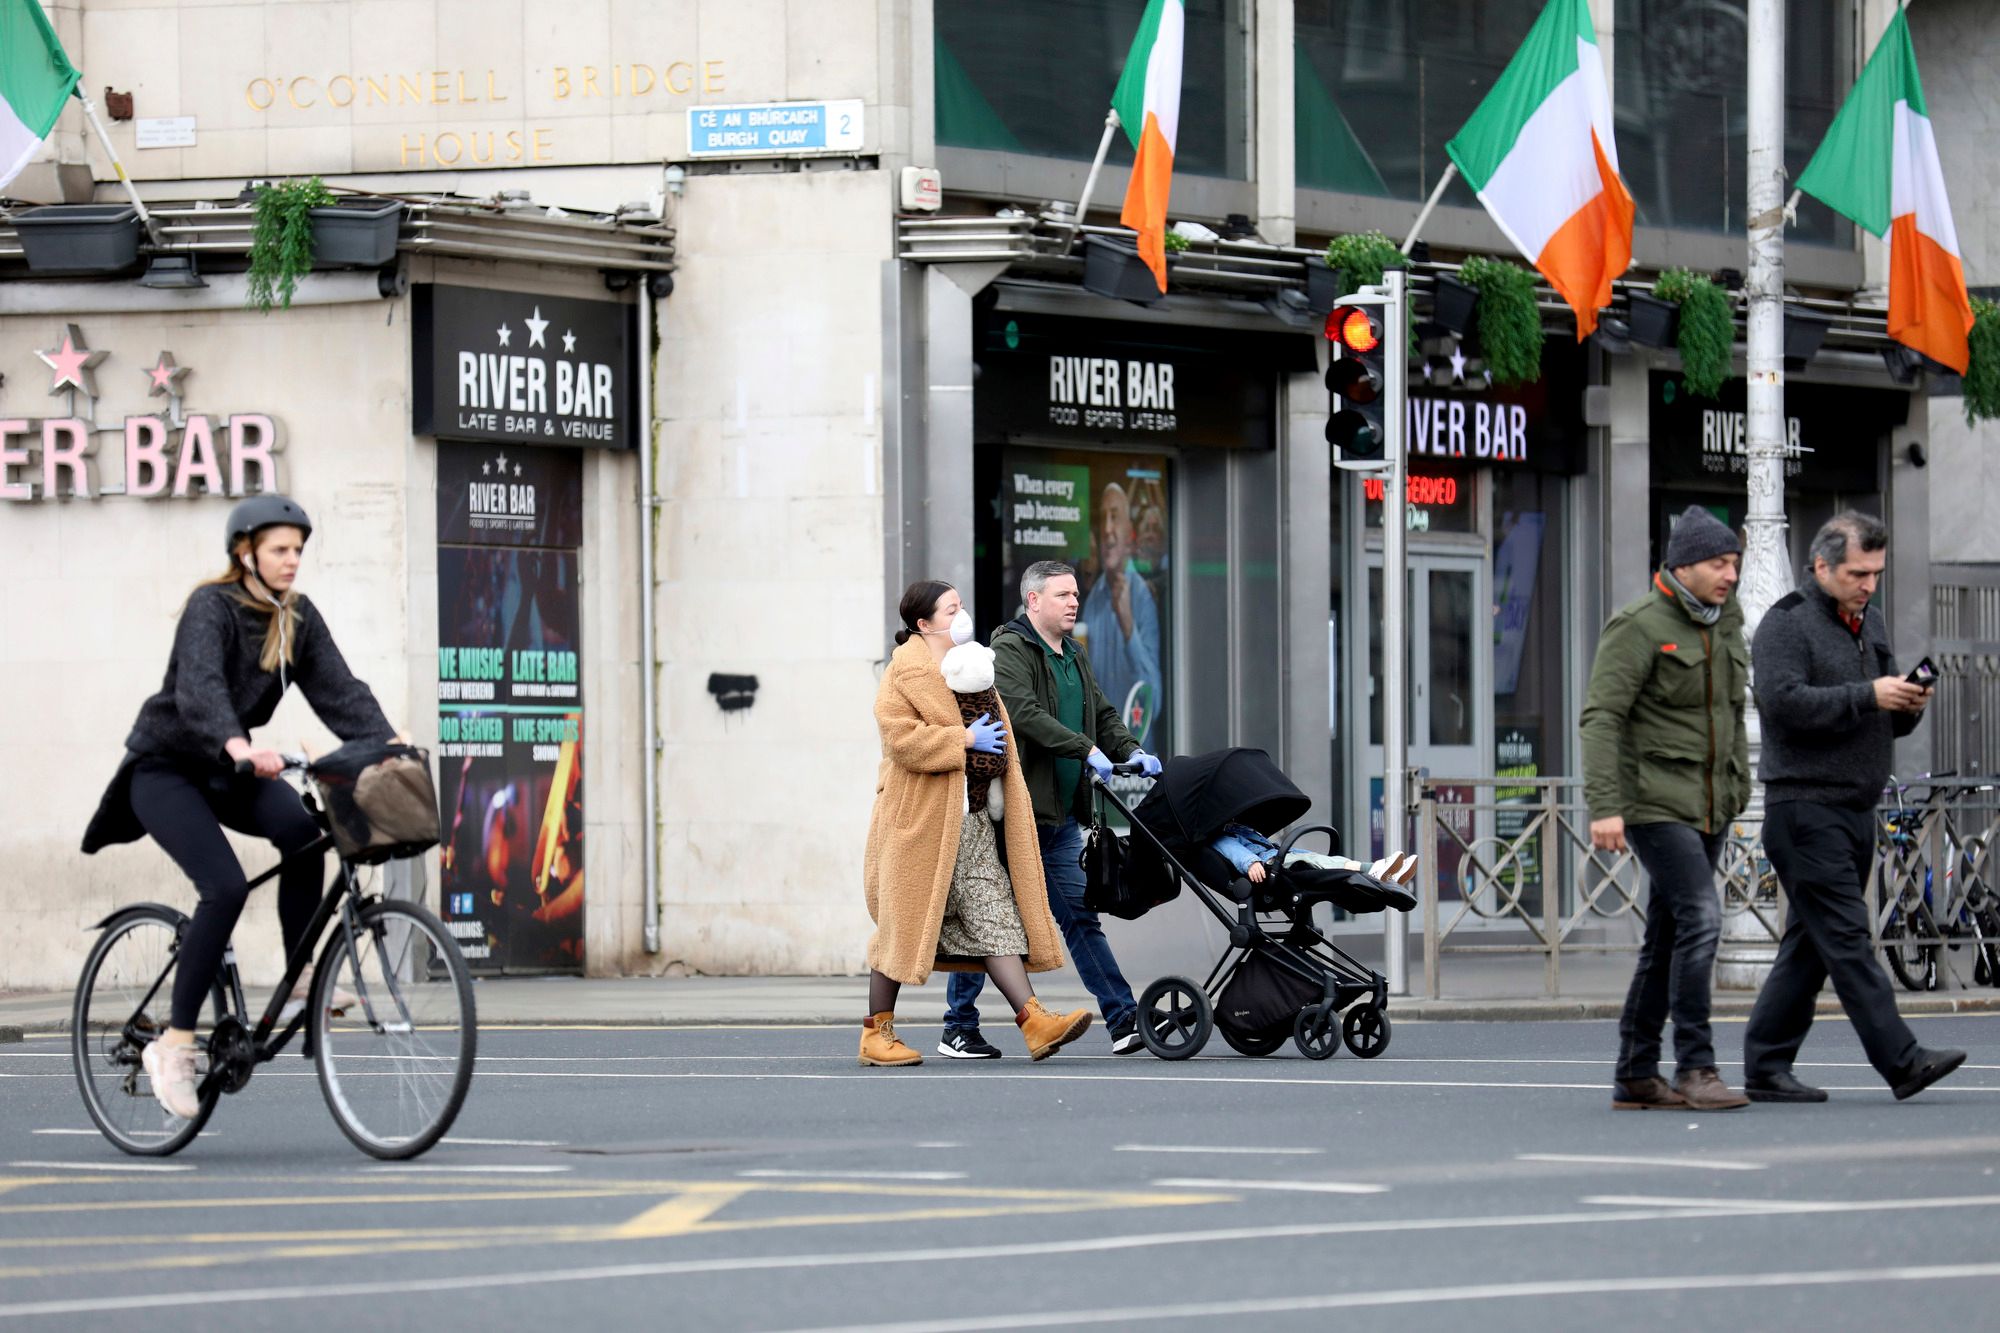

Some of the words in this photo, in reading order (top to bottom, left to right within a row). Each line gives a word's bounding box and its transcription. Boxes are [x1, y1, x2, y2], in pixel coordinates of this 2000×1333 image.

[245, 68, 508, 112] O'CONNELL
[553, 59, 726, 101] BRIDGE
[723, 111, 742, 127] AN
[840, 113, 851, 135] 2
[402, 128, 554, 167] HOUSE
[707, 130, 759, 147] BURGH
[768, 128, 808, 146] QUAY
[458, 350, 548, 414] RIVER
[555, 359, 614, 420] BAR
[1050, 355, 1121, 408] RIVER
[1127, 360, 1175, 411] BAR
[458, 412, 498, 431] LATE
[504, 415, 538, 434] BAR
[543, 419, 555, 436] &
[561, 420, 614, 441] VENUE
[1050, 406, 1079, 426] FOOD
[1084, 409, 1125, 430] SPORTS
[1129, 412, 1155, 431] LATE
[1156, 413, 1177, 431] BAR
[1475, 401, 1527, 461] BAR
[124, 413, 279, 498] BAR
[469, 481, 507, 514] RIVER
[509, 483, 536, 515] BAR
[1013, 473, 1043, 495] When
[1044, 480, 1075, 501] every
[1013, 500, 1035, 523] pub
[1035, 500, 1081, 522] becomes
[1014, 528, 1021, 545] a
[459, 647, 504, 681] MUSIC
[512, 650, 545, 682] LATE
[547, 651, 577, 683] BAR
[460, 682, 495, 700] WEEKEND
[461, 717, 504, 742] SERVED
[512, 718, 536, 742] LIVE
[537, 718, 579, 742] SPORTS
[533, 745, 560, 761] SHOWN
[951, 1035, 966, 1051] N
